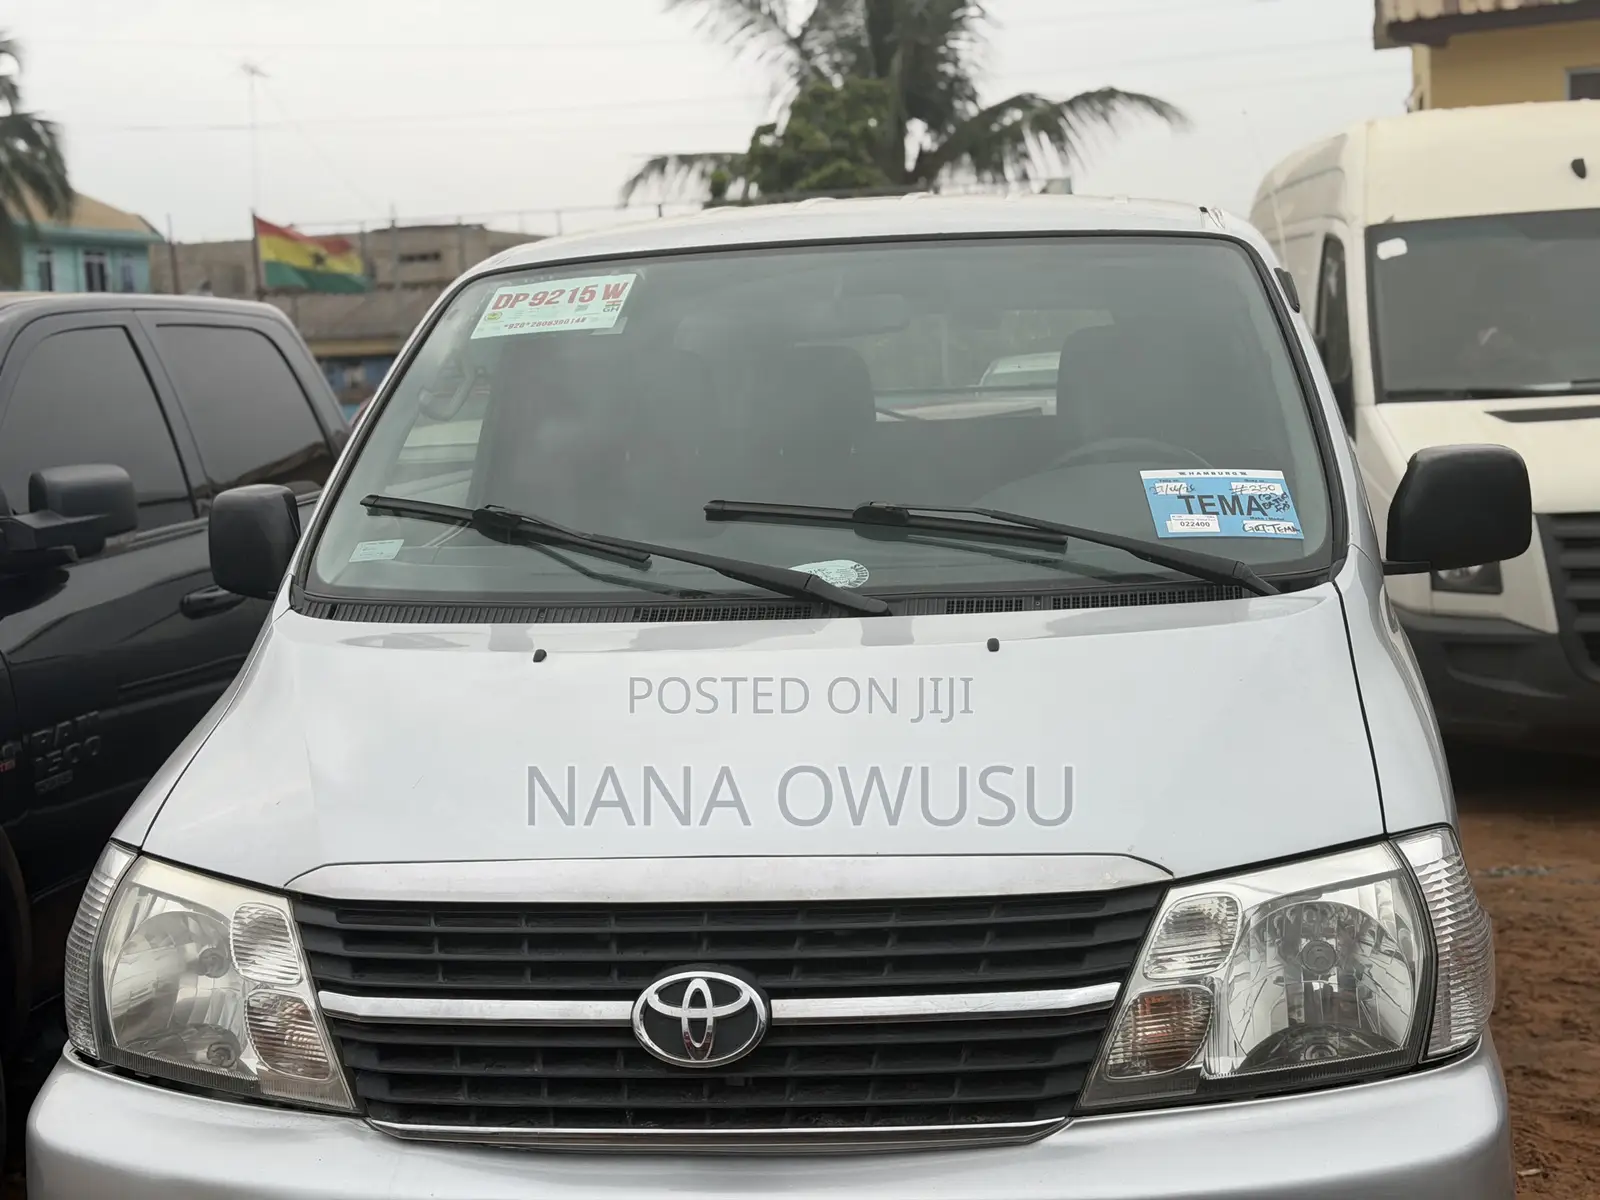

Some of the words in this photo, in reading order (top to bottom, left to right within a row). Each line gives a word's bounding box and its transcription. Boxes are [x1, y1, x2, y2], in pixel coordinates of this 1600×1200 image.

[491, 293, 530, 310] DP
[528, 284, 599, 307] 9215
[602, 282, 629, 301] W
[1177, 494, 1268, 517] TEMA
